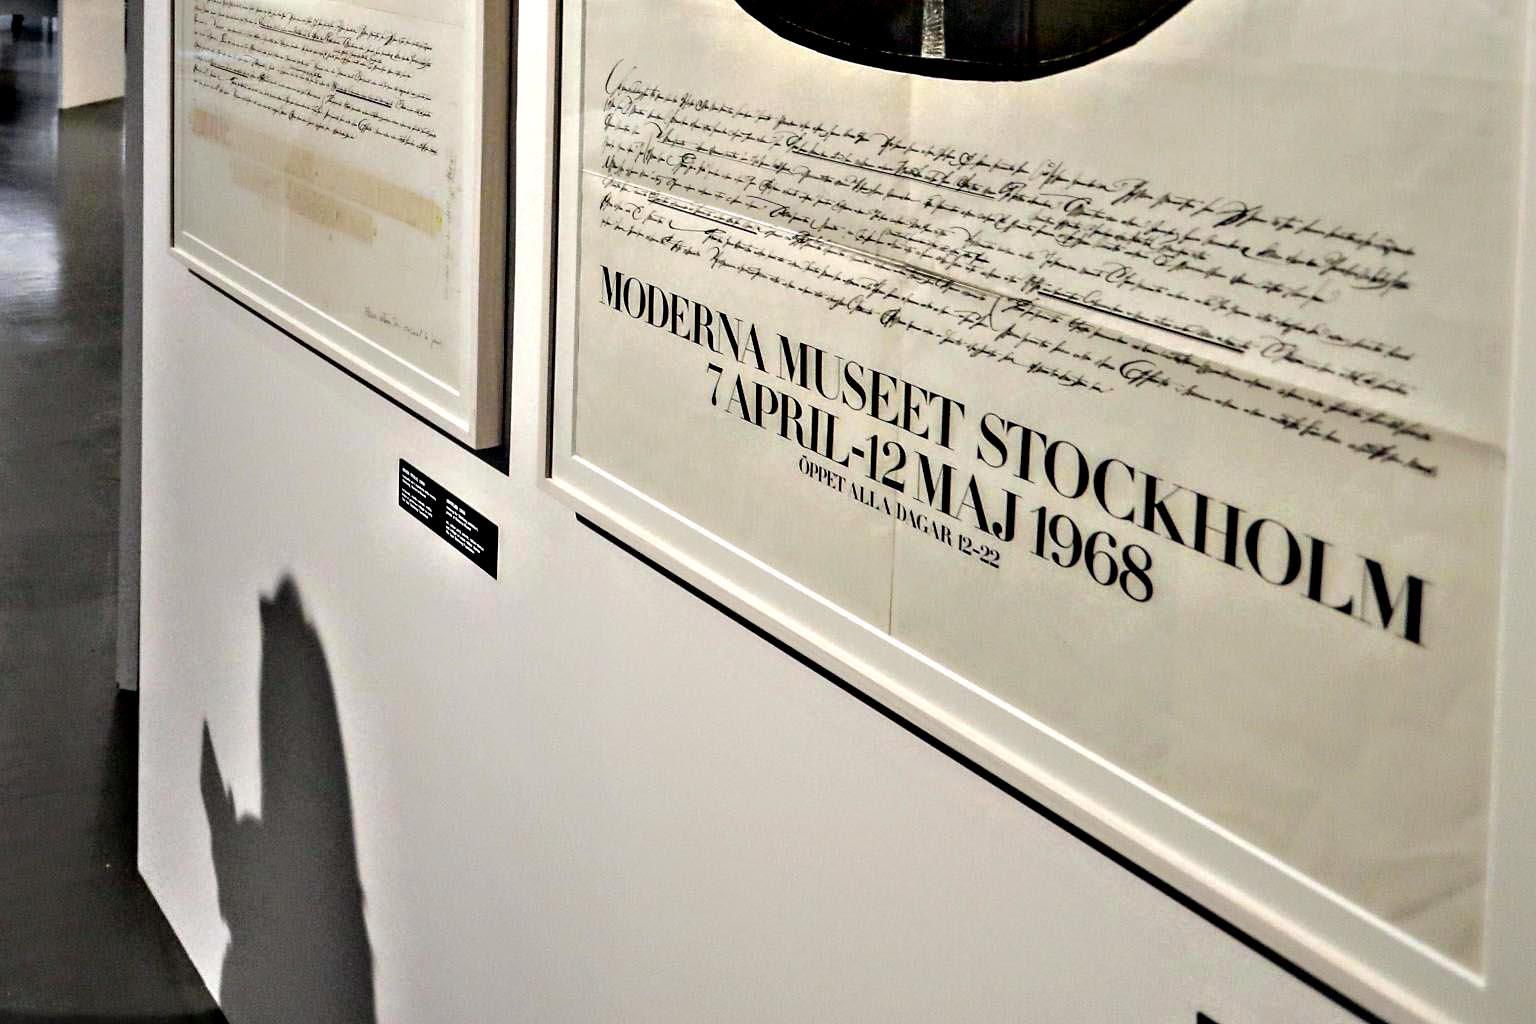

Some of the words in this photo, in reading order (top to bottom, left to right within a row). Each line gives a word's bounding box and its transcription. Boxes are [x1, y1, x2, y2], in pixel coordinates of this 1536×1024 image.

[598, 264, 770, 374] MODERNA
[775, 332, 966, 452] MUSEET
[976, 411, 1432, 649] STOCKHOLM
[705, 361, 724, 407] 7
[912, 450, 1024, 543] MAJ
[1029, 505, 1155, 604] 1968
[798, 454, 847, 494] ÖPPET
[849, 481, 892, 516] ALLA
[895, 501, 954, 548] DAGAR
[957, 533, 1001, 570] 12-22
